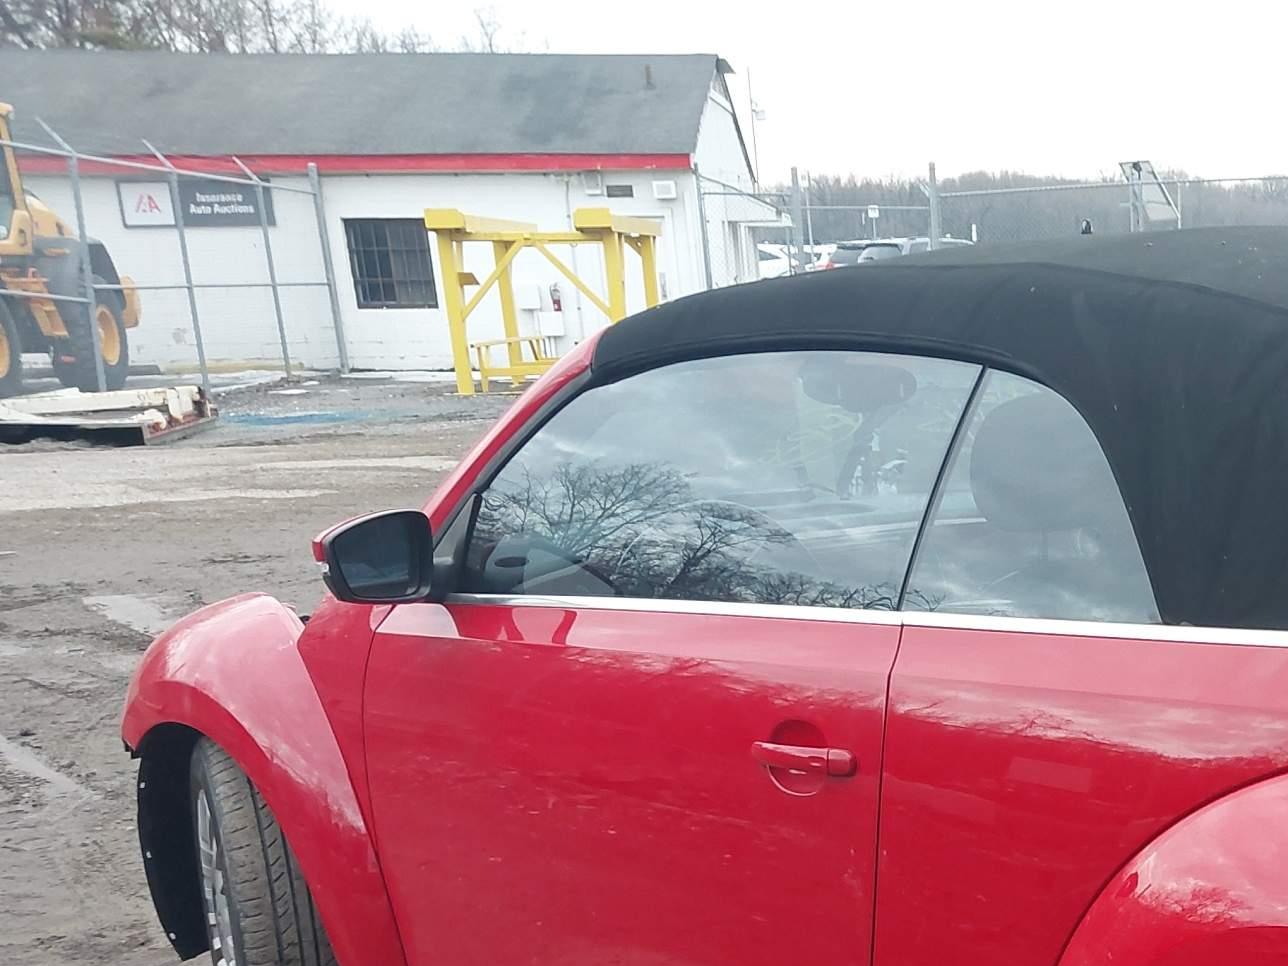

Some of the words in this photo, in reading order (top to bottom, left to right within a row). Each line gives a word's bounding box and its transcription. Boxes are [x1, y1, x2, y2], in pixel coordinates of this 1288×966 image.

[195, 192, 244, 202] Insurance
[189, 204, 212, 214] Auto
[213, 203, 255, 214] Auctions
